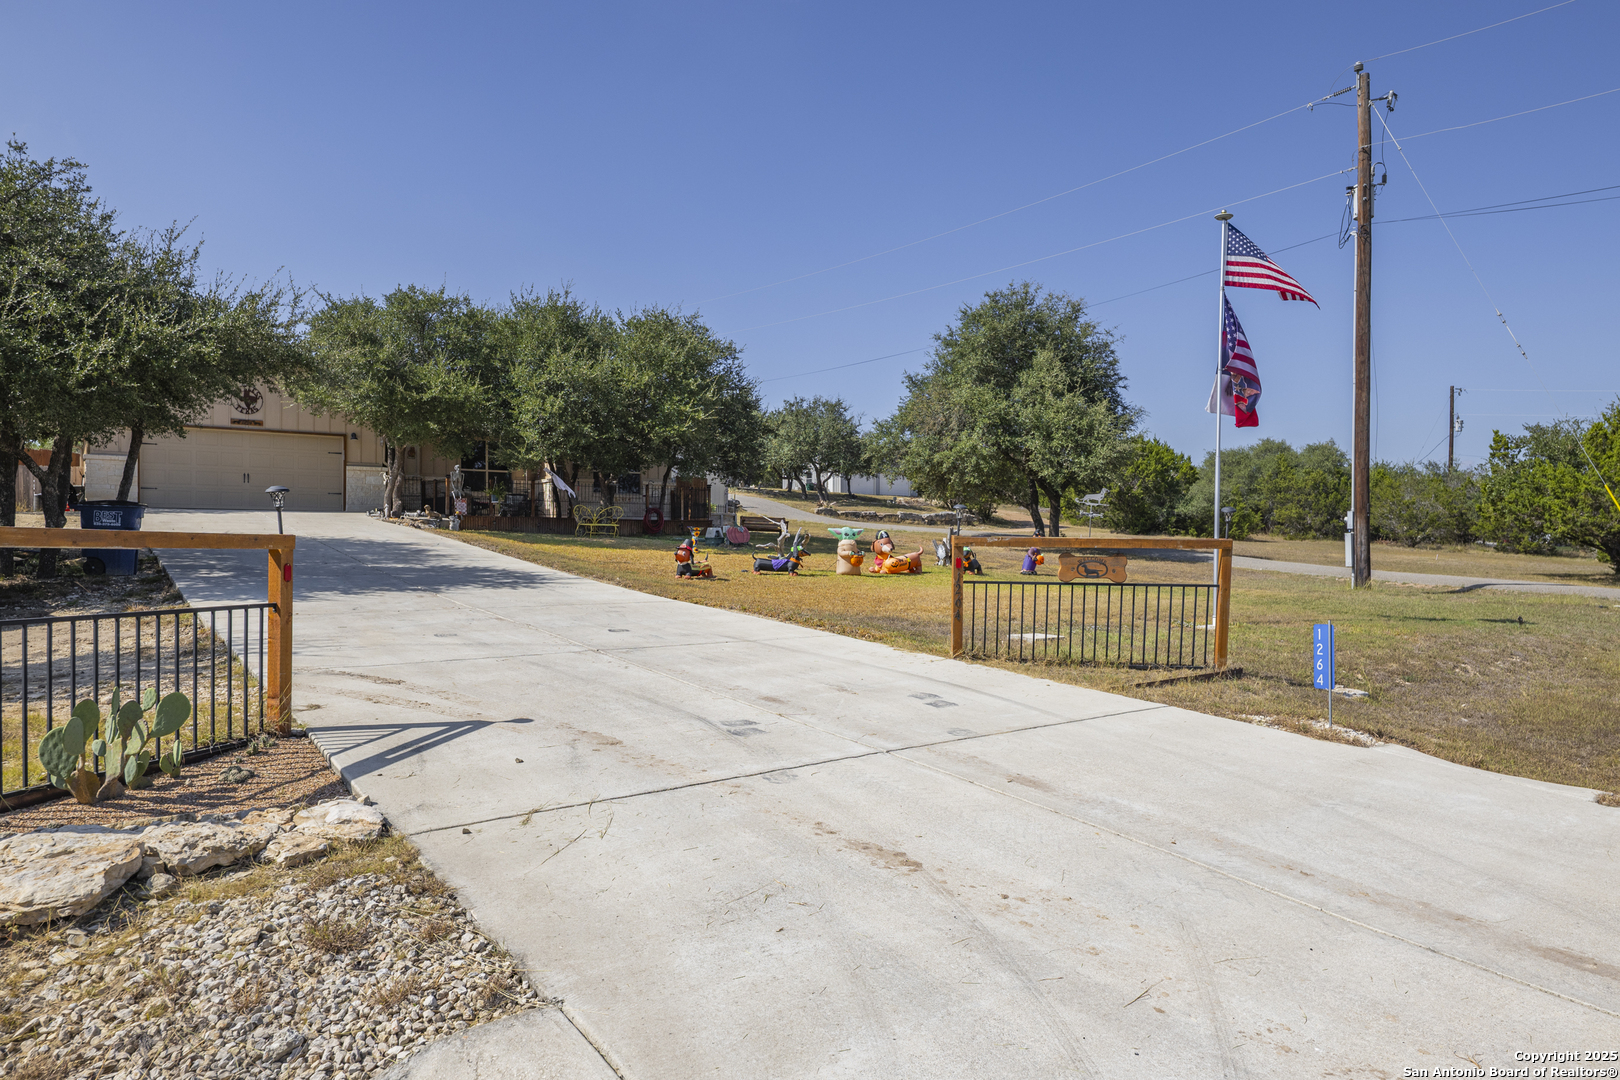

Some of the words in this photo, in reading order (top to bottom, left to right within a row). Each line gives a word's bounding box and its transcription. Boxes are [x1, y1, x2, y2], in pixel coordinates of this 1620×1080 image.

[93, 510, 123, 524] BEST
[954, 572, 962, 621] 1264
[1316, 628, 1324, 686] 1264
